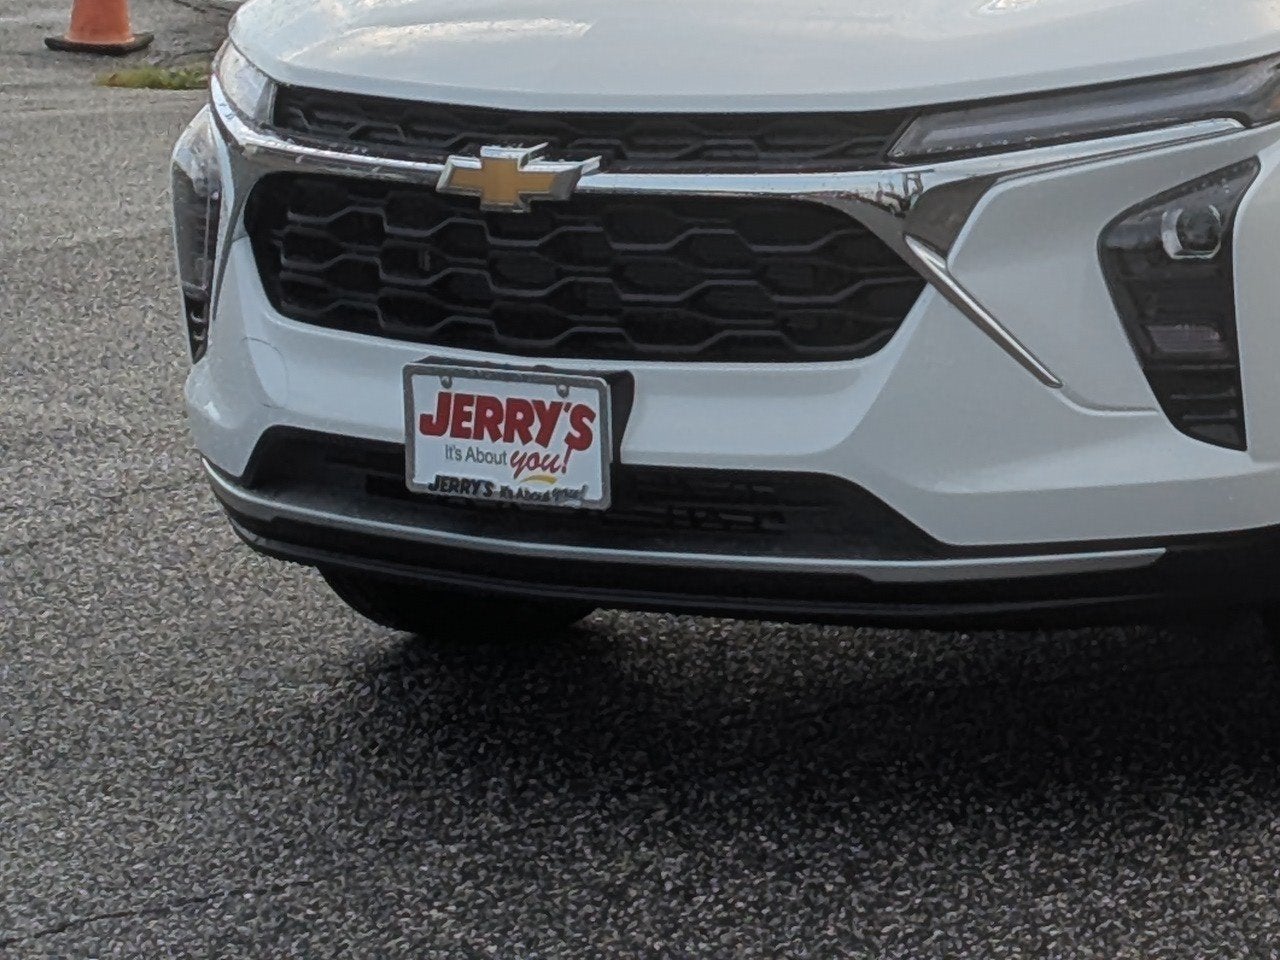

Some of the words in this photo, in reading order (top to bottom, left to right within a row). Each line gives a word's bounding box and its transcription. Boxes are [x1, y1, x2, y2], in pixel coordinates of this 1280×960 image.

[419, 391, 596, 451] JERRY'S
[445, 444, 463, 462] It's
[465, 446, 507, 466] About
[509, 445, 573, 480] you!
[428, 475, 496, 498] JERRY'S
